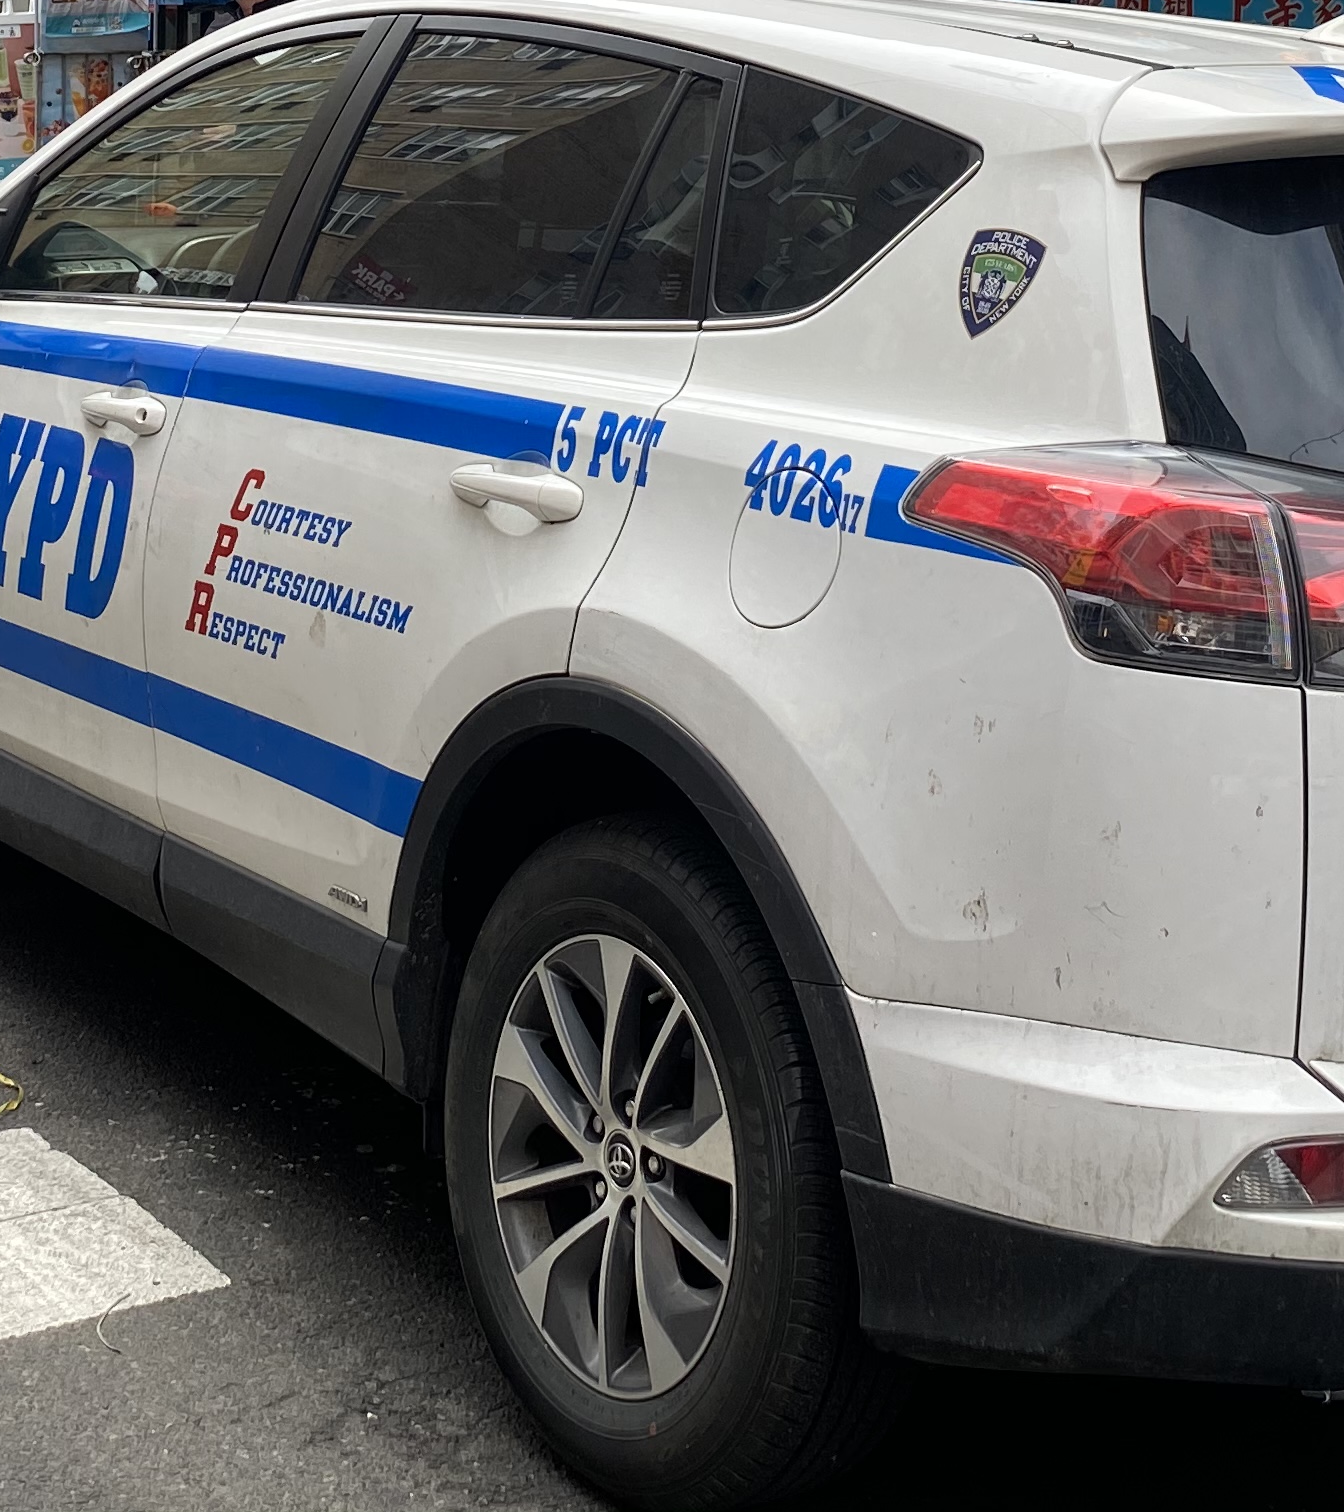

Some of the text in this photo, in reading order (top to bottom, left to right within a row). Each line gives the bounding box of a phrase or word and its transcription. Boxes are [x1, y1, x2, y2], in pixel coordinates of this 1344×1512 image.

[971, 242, 1037, 268] DEPARTMENT
[992, 232, 1029, 249] POLICE
[962, 267, 971, 311] CITY OF
[989, 275, 1031, 323] NEW YORK
[557, 405, 666, 487] 5 PCT
[229, 469, 352, 547] COURTESY
[744, 439, 865, 535] 4026 17
[204, 523, 413, 634] PROFESSIONALISM
[185, 580, 285, 660] RESPECT
